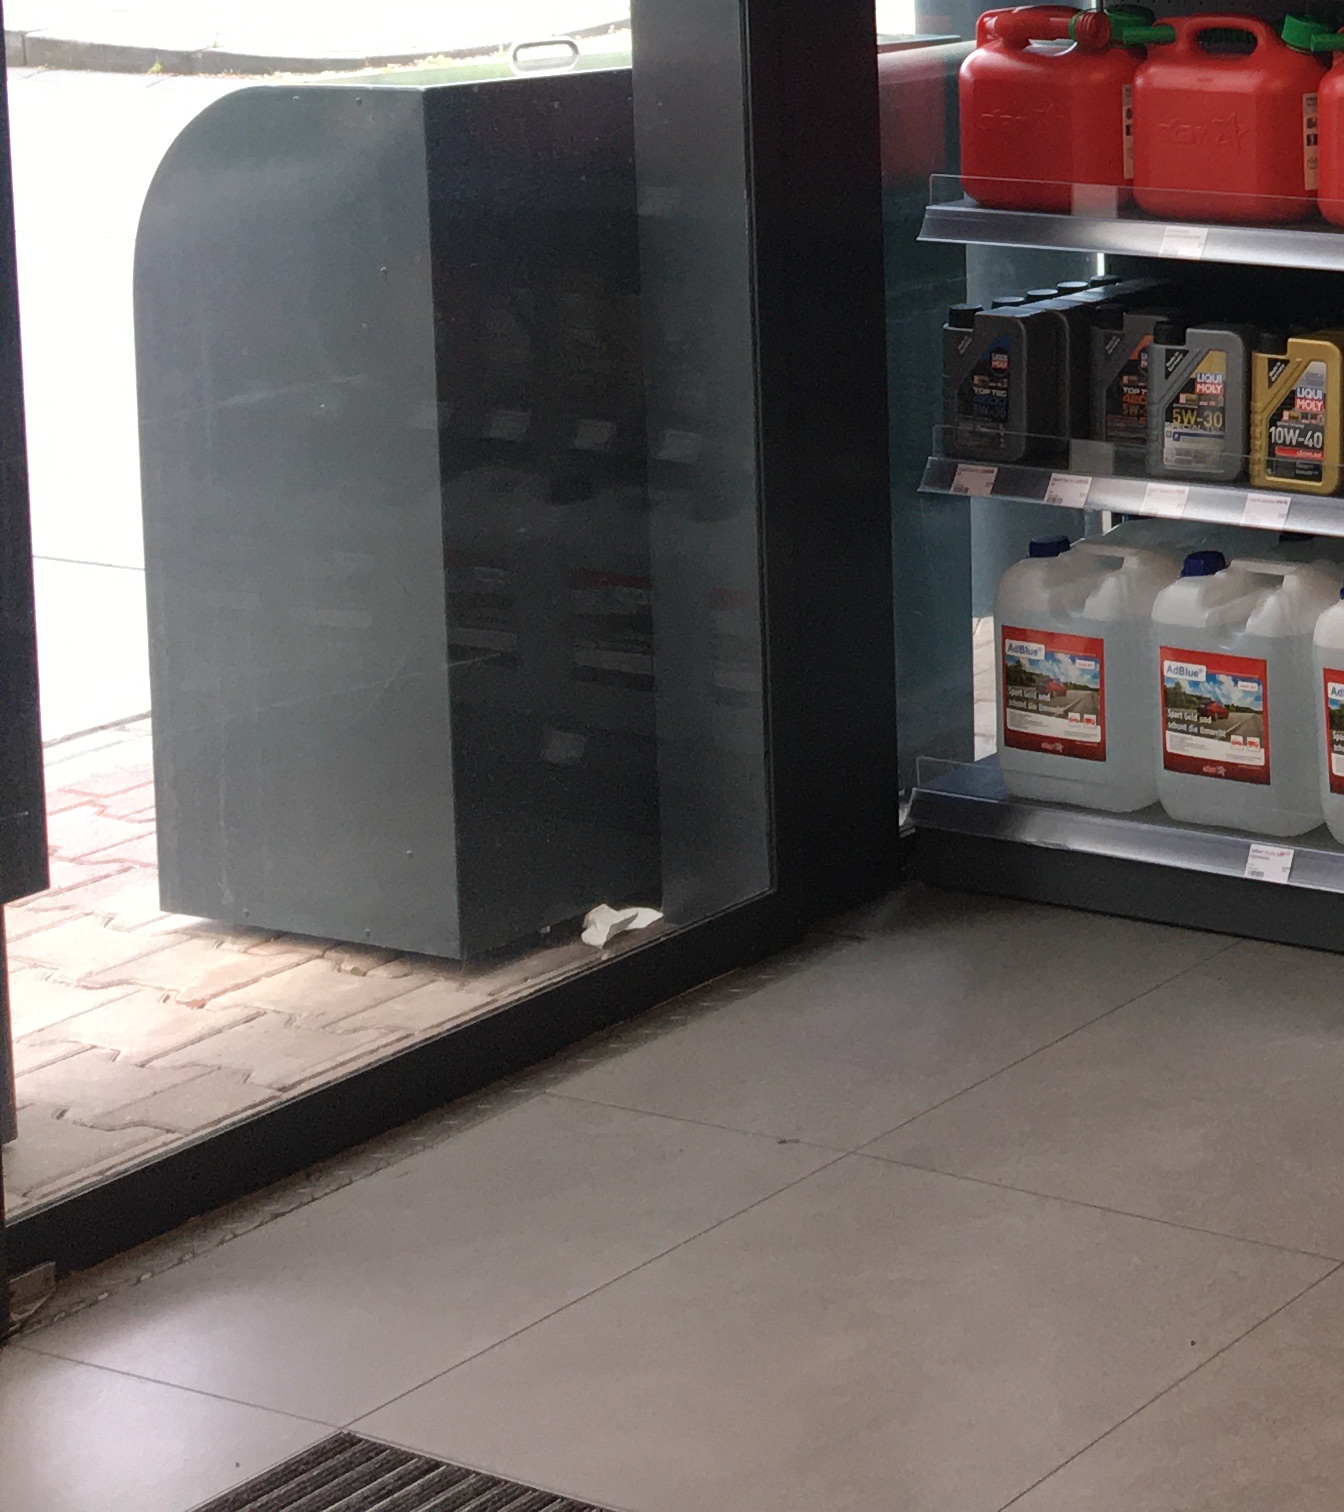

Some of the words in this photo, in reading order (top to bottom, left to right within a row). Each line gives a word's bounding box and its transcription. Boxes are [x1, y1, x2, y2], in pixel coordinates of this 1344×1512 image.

[1197, 374, 1223, 383] LIQUI
[1196, 384, 1223, 394] MOLY
[1297, 389, 1323, 399] LIQUI
[1296, 399, 1323, 411] MOLY
[1172, 409, 1223, 428] 5W-30
[1269, 426, 1323, 448] 10W-40
[1008, 643, 1038, 656] AdBlue
[1166, 664, 1199, 678] AdBlue
